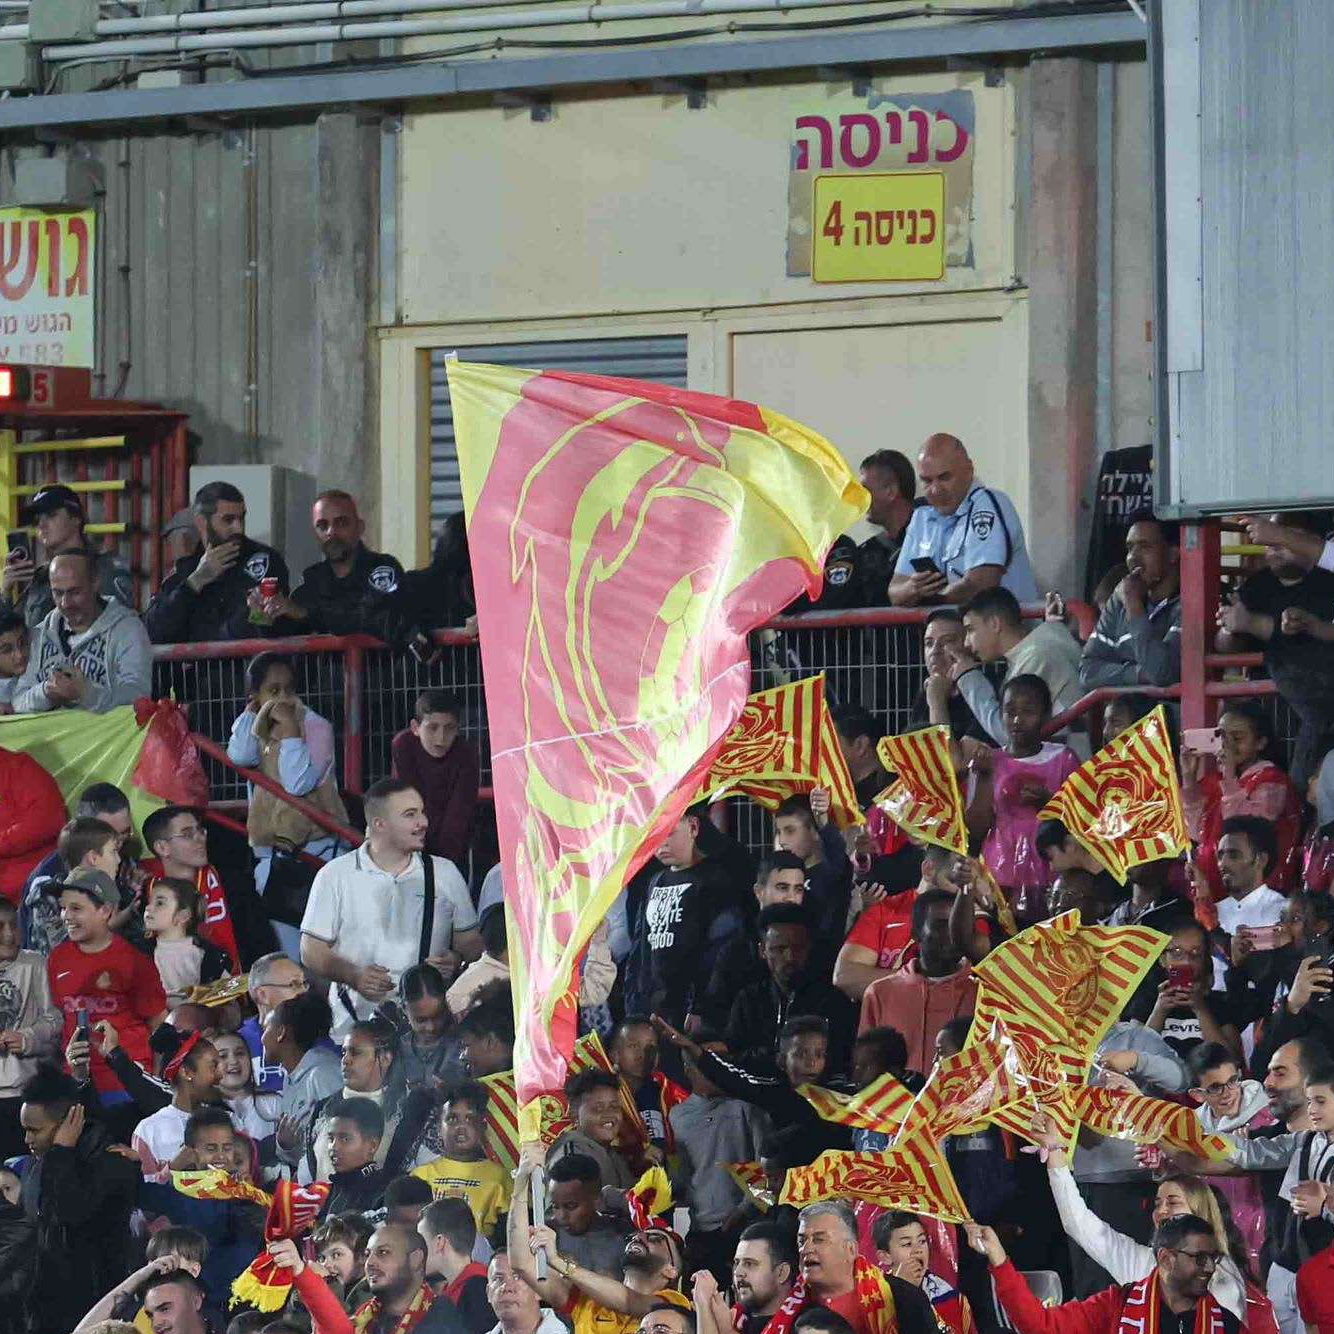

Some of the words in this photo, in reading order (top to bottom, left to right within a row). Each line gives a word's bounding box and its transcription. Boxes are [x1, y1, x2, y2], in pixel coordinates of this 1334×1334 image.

[795, 110, 968, 170] כניסה
[821, 201, 844, 246] 4
[854, 210, 936, 246] כניסה
[25, 312, 73, 333] הגוש
[33, 373, 49, 403] 5
